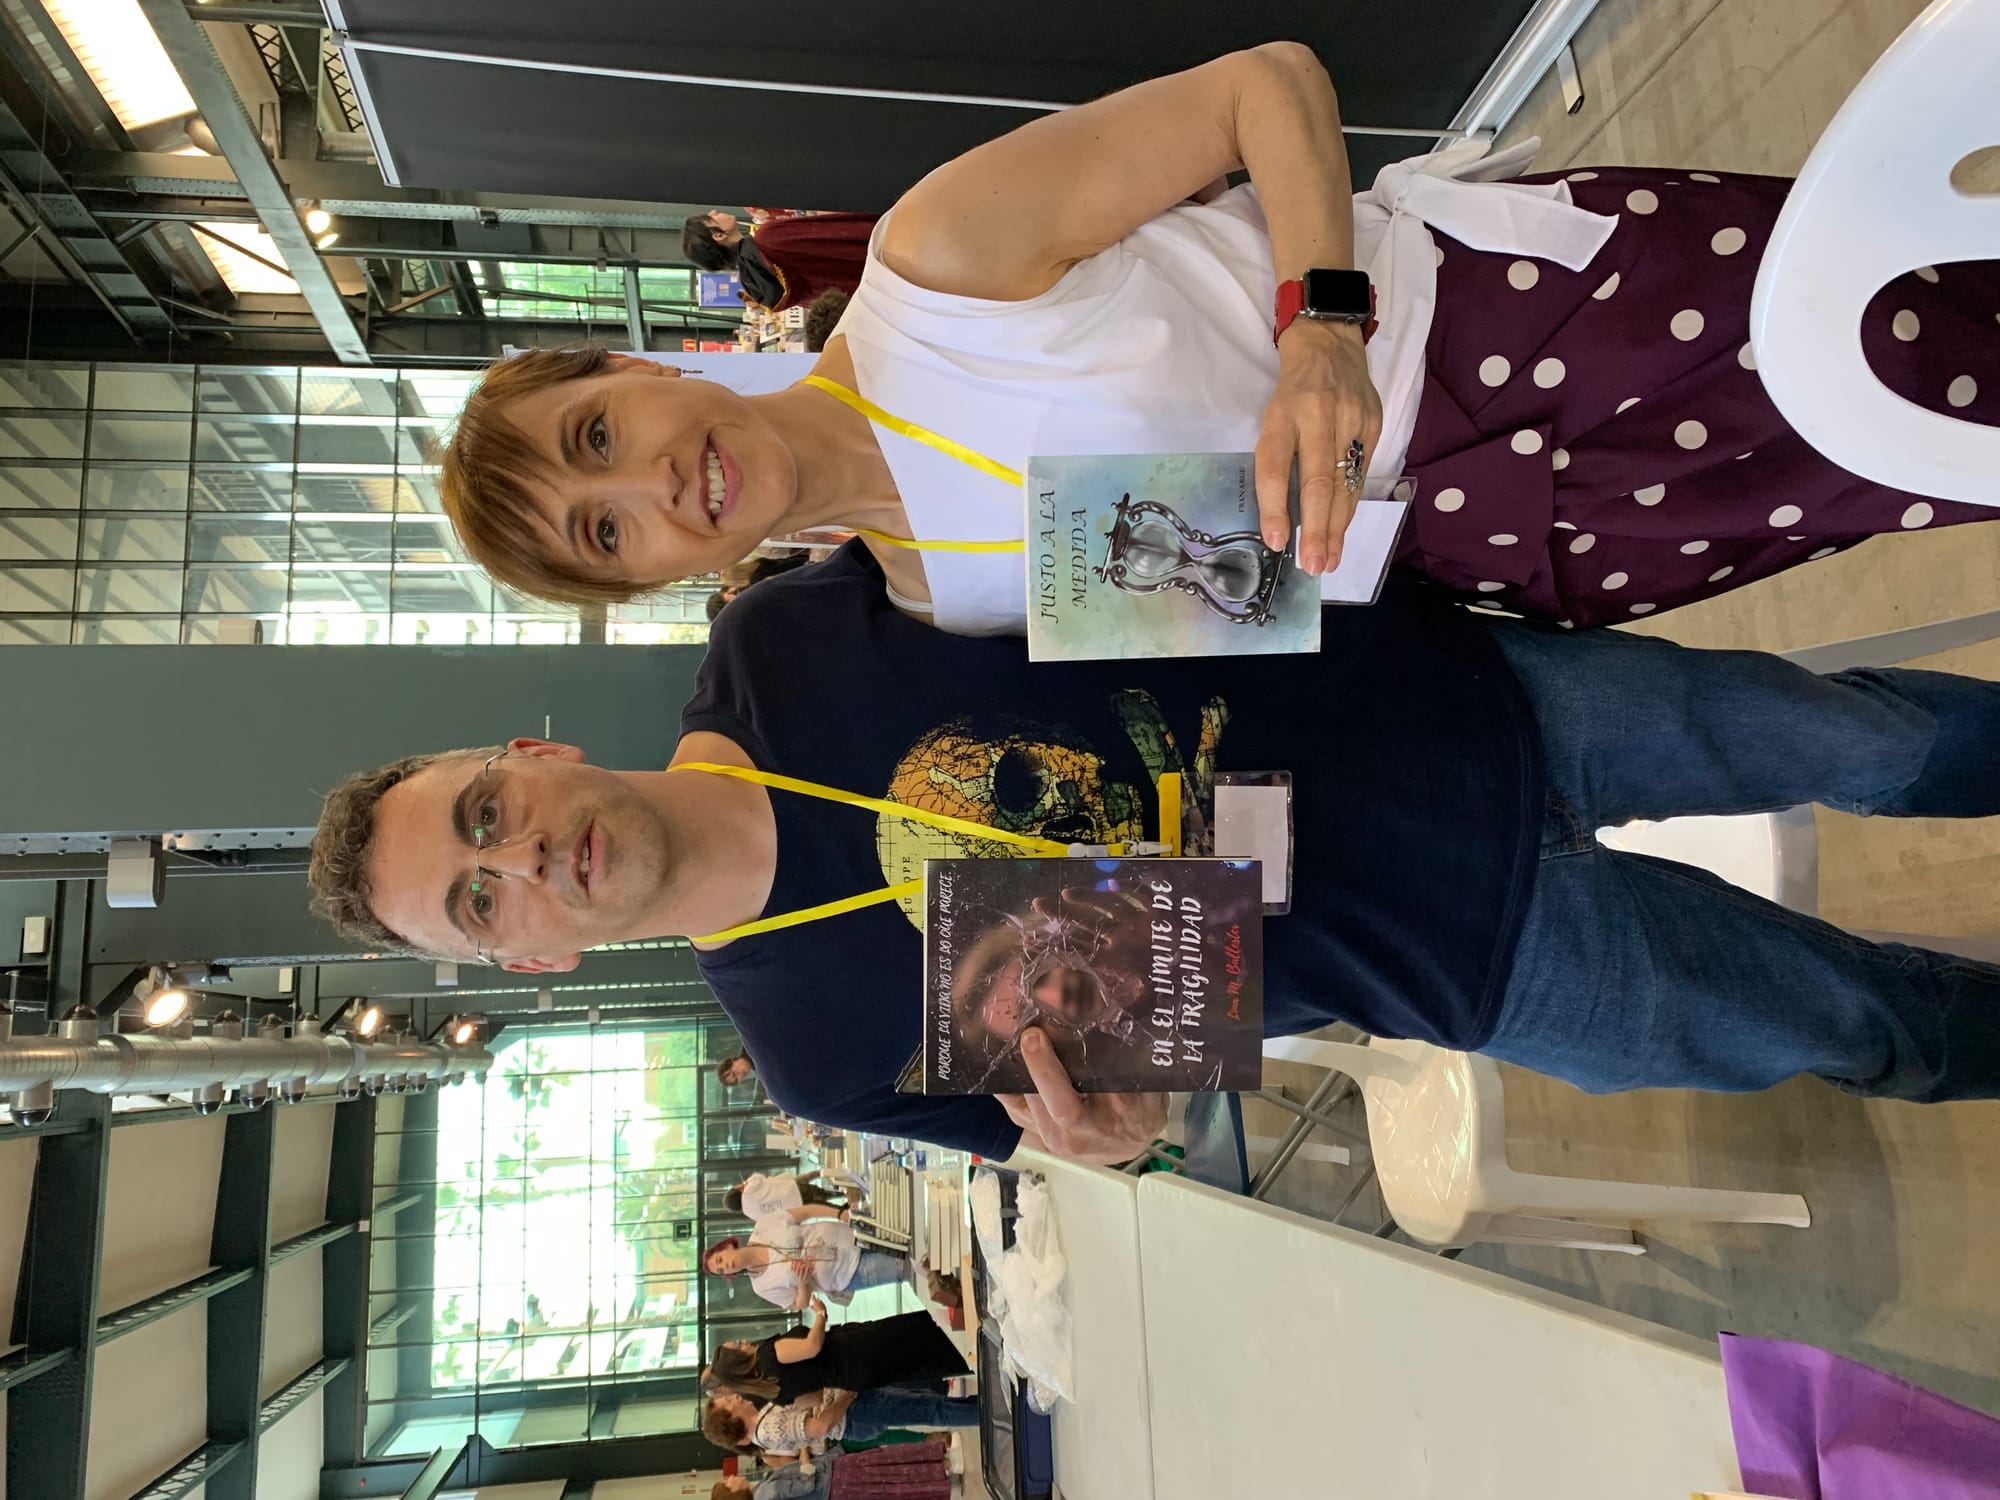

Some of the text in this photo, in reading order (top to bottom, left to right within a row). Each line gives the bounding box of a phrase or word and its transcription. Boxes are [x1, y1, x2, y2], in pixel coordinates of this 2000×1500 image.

[1040, 490, 1058, 624] JUSTO A LA
[1071, 508, 1086, 609] MEDIDA
[902, 857, 912, 915] EUOPE
[939, 917, 953, 938] QUE
[1224, 923, 1241, 975] Ballester
[939, 956, 952, 971] ES
[1148, 880, 1175, 1067] EN EL LÍMITE DE
[1179, 897, 1209, 1063] LA FRAGILIDAD
[938, 991, 952, 1019] VIDA
[938, 1037, 952, 1081] PORQUE
